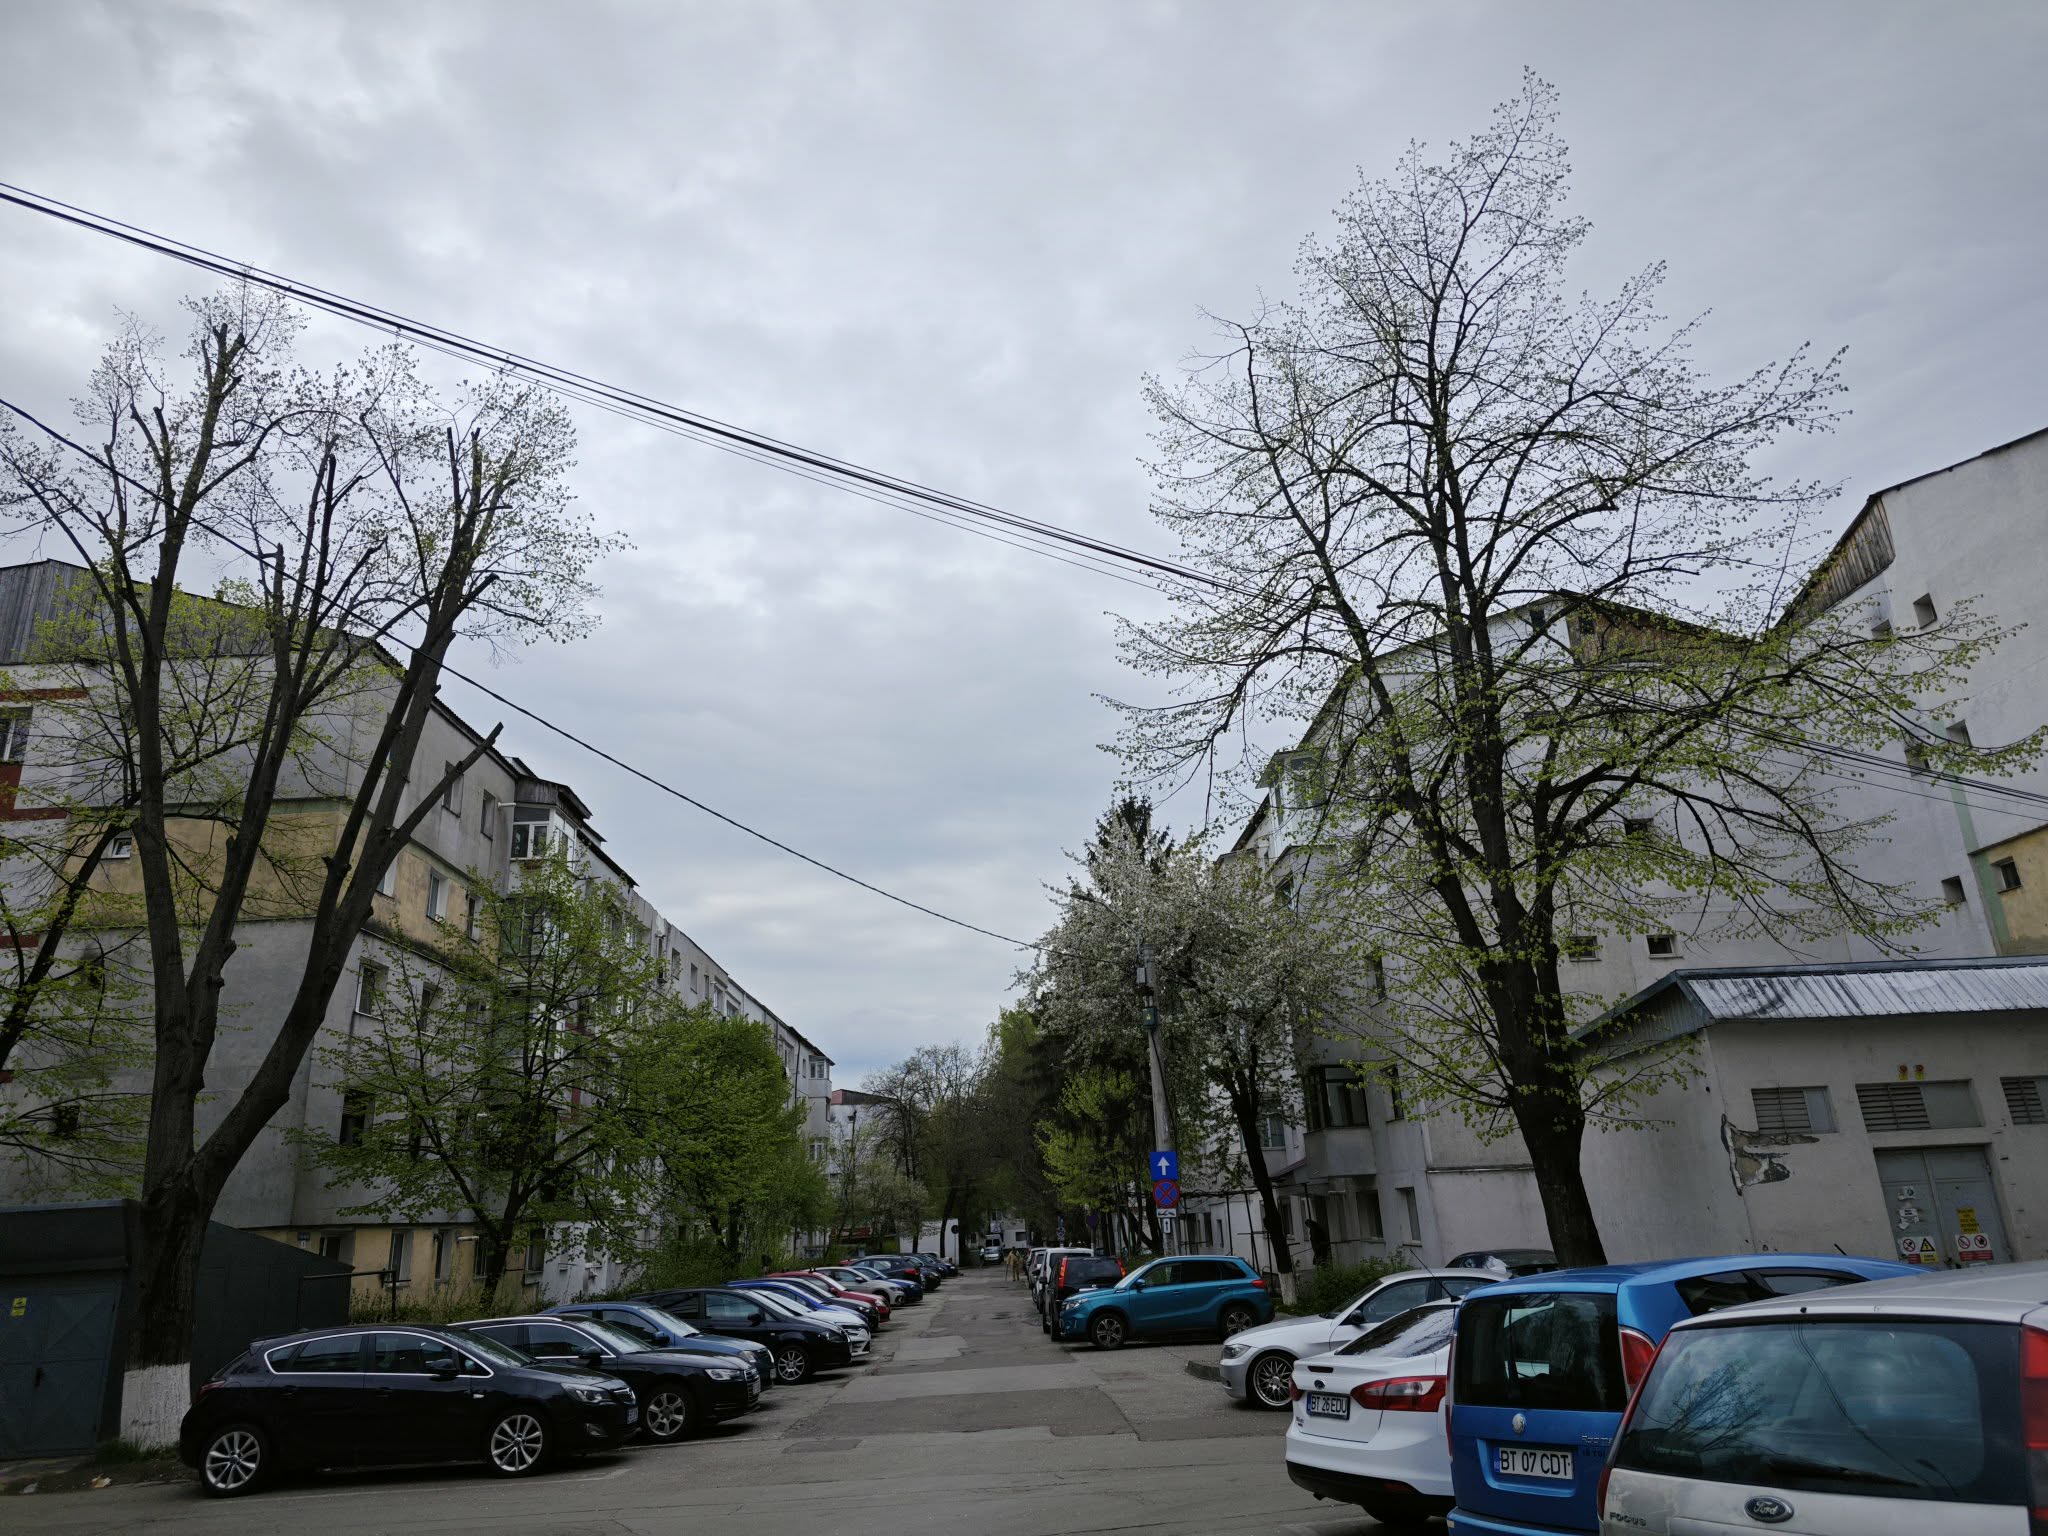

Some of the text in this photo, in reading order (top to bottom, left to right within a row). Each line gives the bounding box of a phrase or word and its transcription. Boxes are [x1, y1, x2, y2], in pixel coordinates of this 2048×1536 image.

[1311, 1396, 1320, 1411] BT
[1330, 1398, 1347, 1414] EDU
[1500, 1450, 1569, 1477] BT 07 CDT
[1753, 1500, 1779, 1515] Ford
[1609, 1511, 1648, 1527] FOCUS
